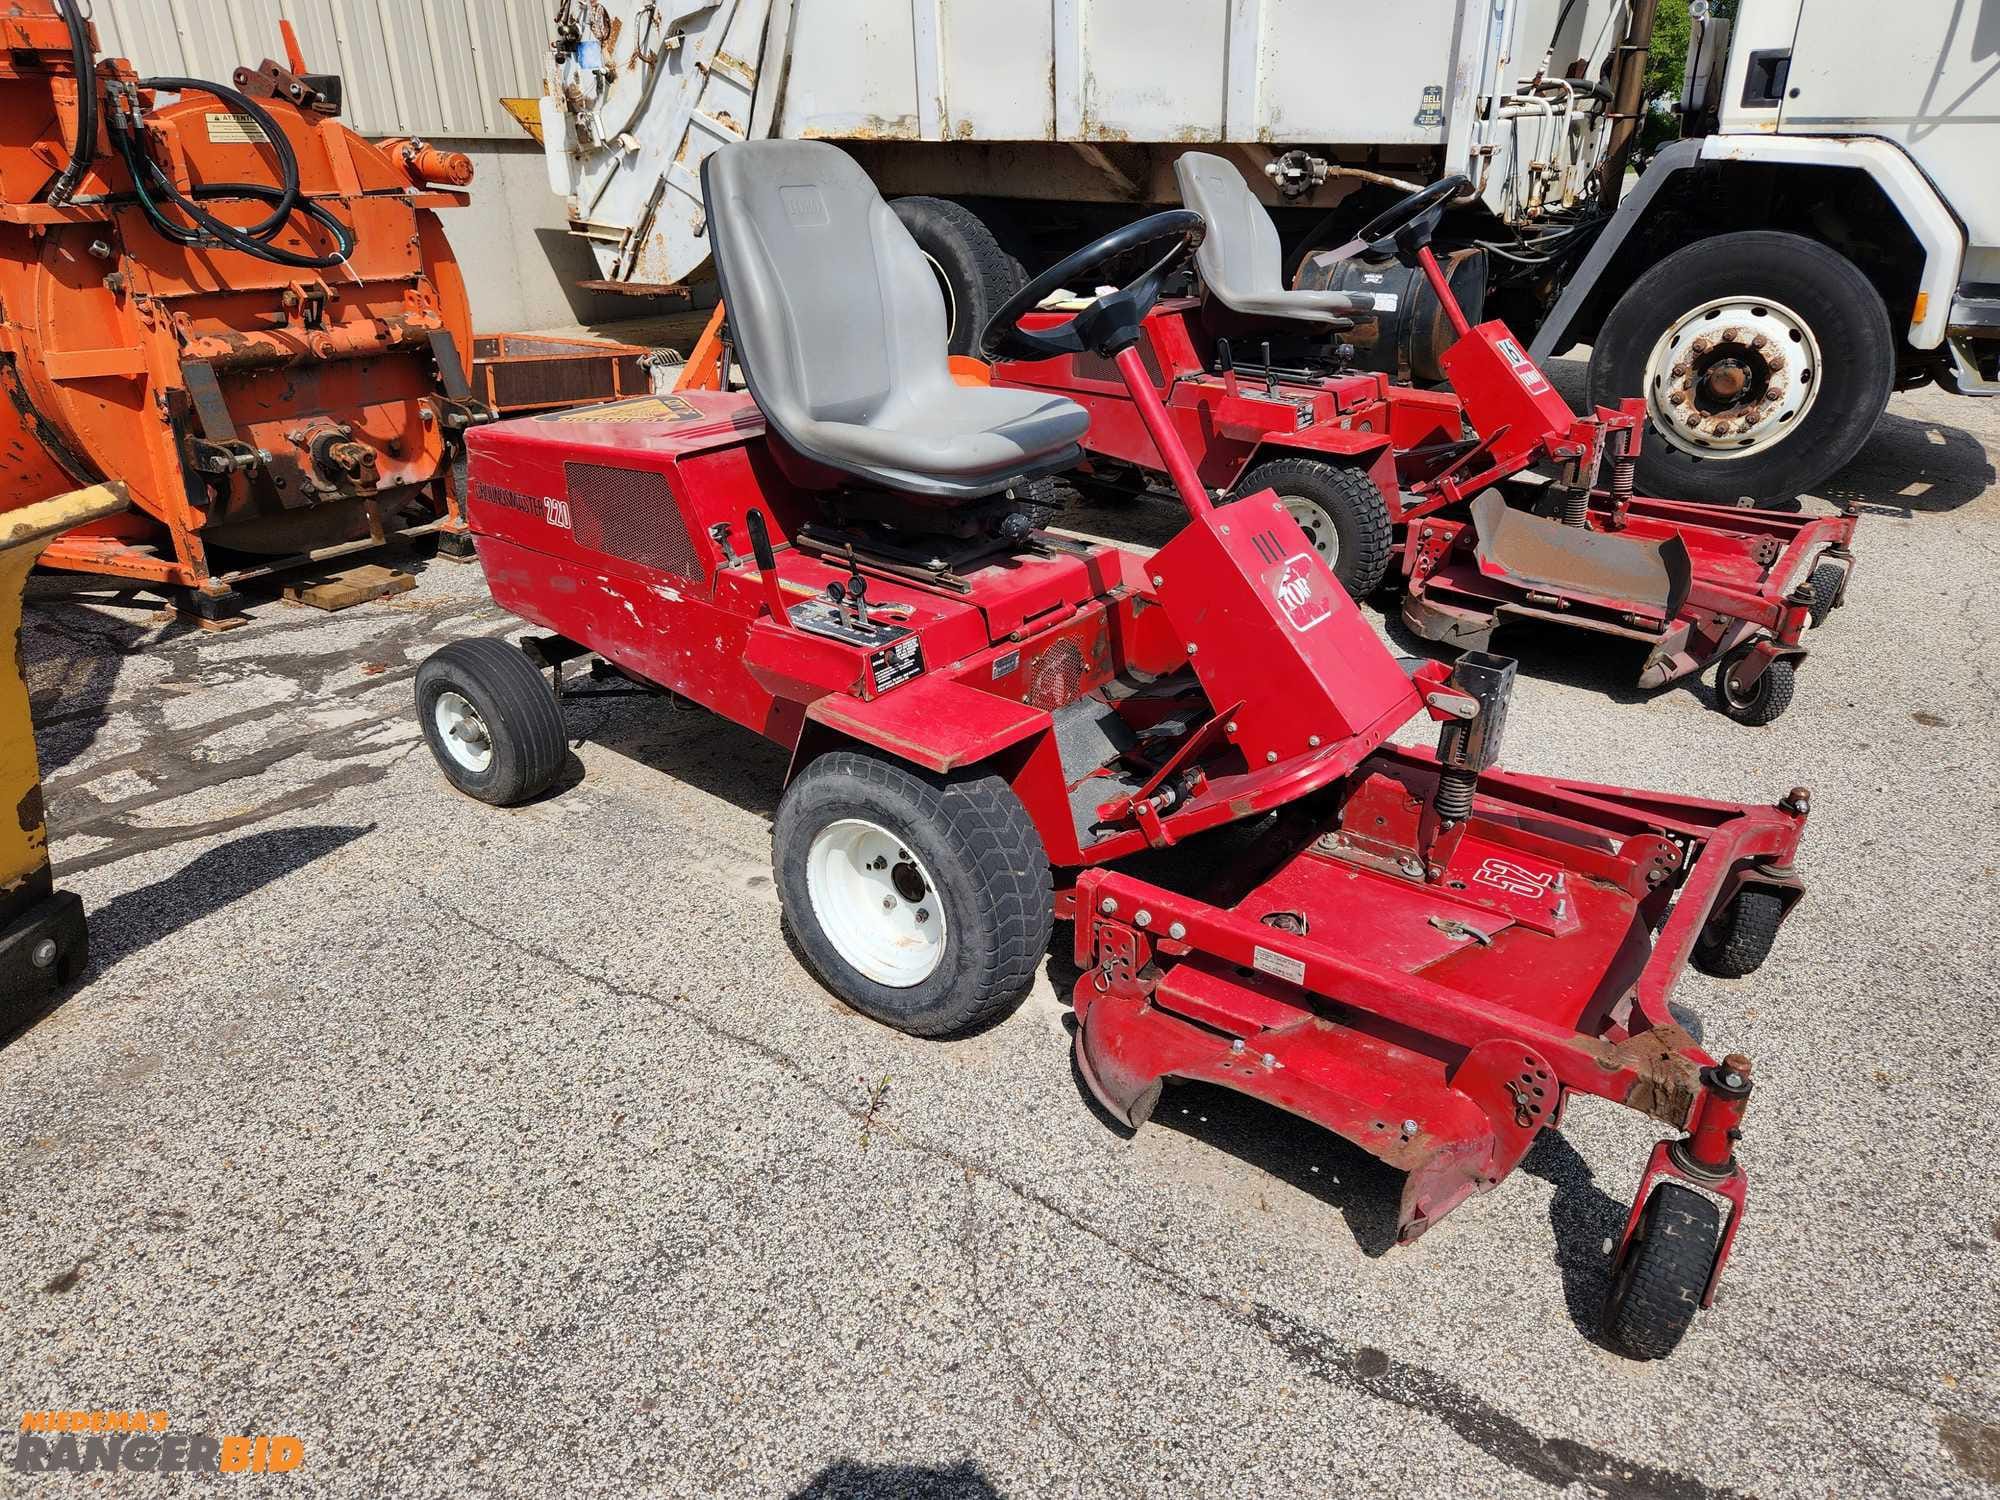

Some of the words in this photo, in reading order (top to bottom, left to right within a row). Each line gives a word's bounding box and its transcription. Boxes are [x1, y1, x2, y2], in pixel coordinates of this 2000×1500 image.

[1423, 94, 1441, 103] BELL
[543, 496, 572, 529] 220
[1472, 858, 1552, 898] 52
